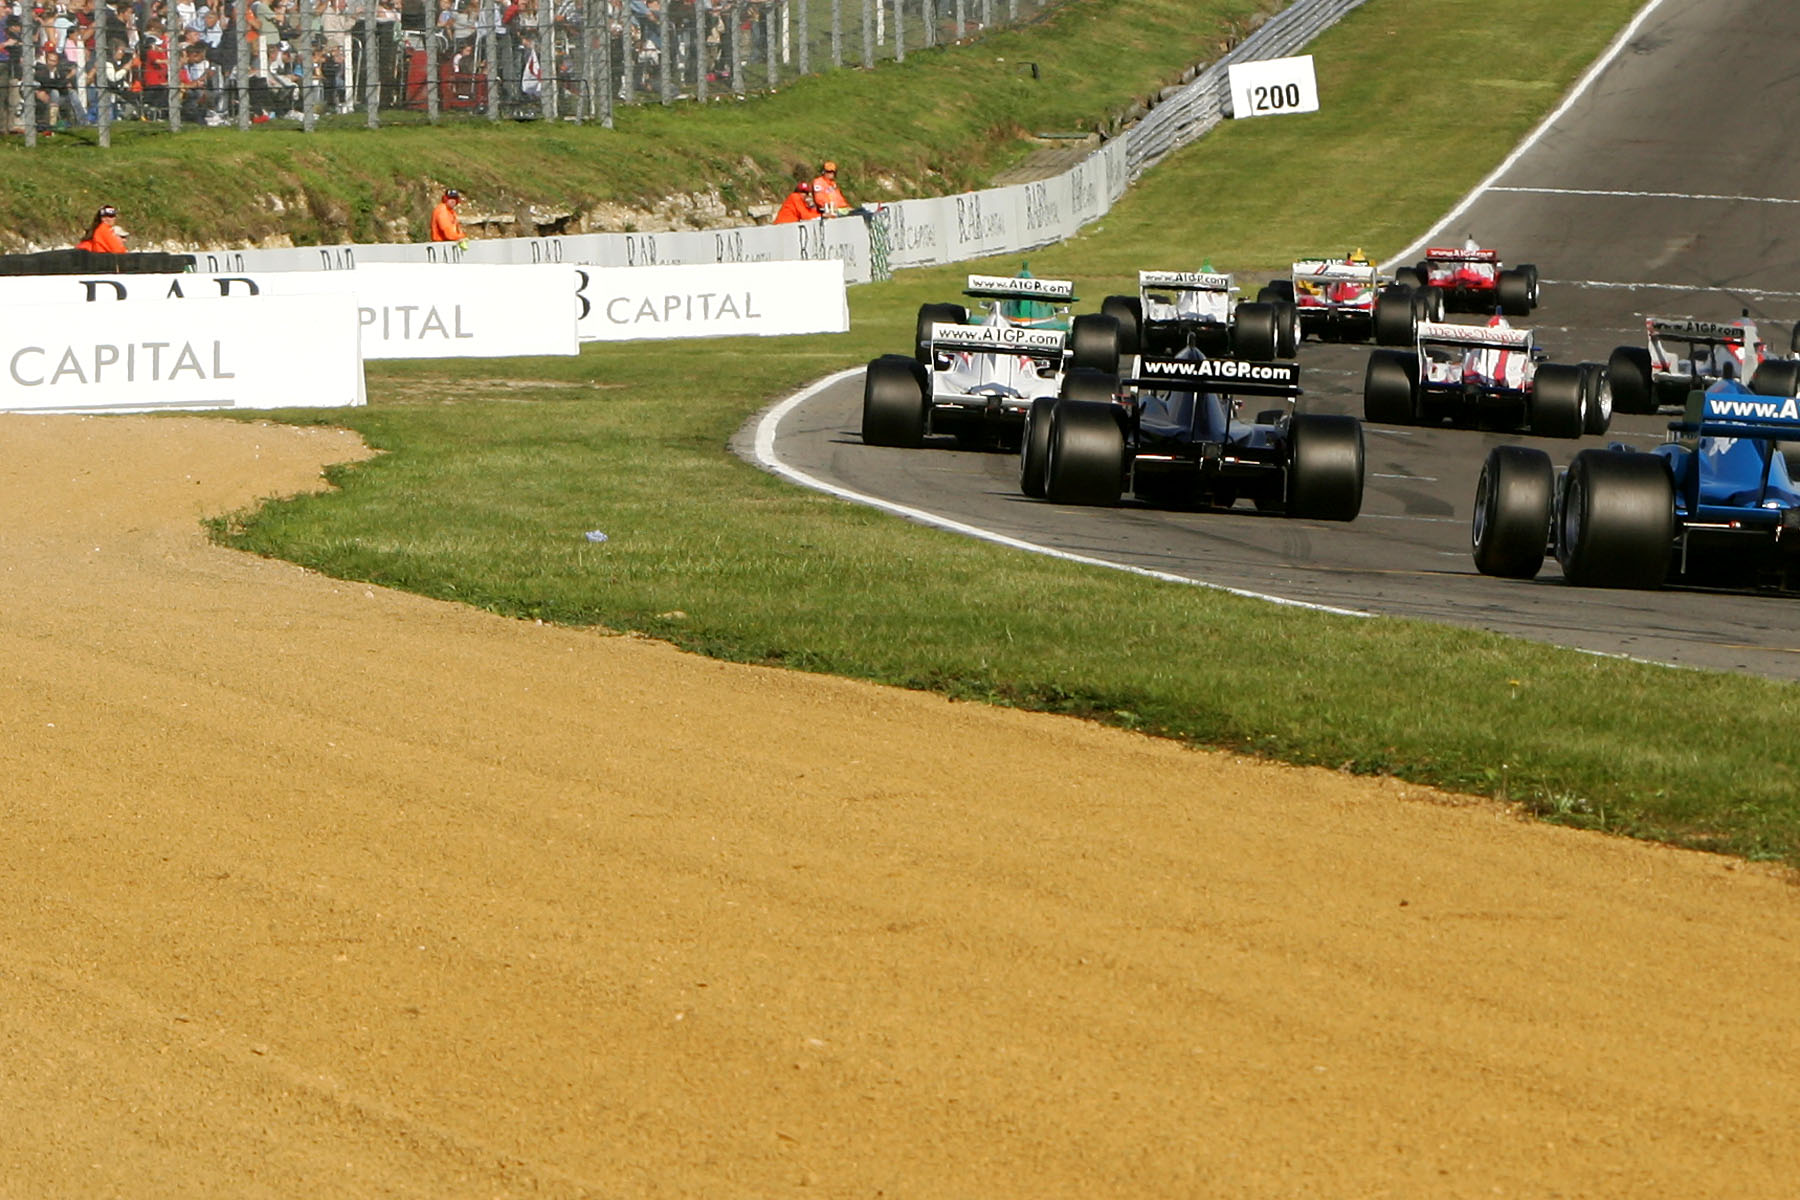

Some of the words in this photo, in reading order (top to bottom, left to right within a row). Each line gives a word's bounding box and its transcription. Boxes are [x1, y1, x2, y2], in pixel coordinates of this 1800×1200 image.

[1254, 83, 1300, 111] 200
[972, 278, 1072, 296] www.A1GP.com
[606, 292, 762, 325] CAPITAL
[938, 326, 1059, 346] www.A1GP.com
[9, 340, 236, 387] CAPITAL
[1145, 360, 1291, 380] www.A1GP.com
